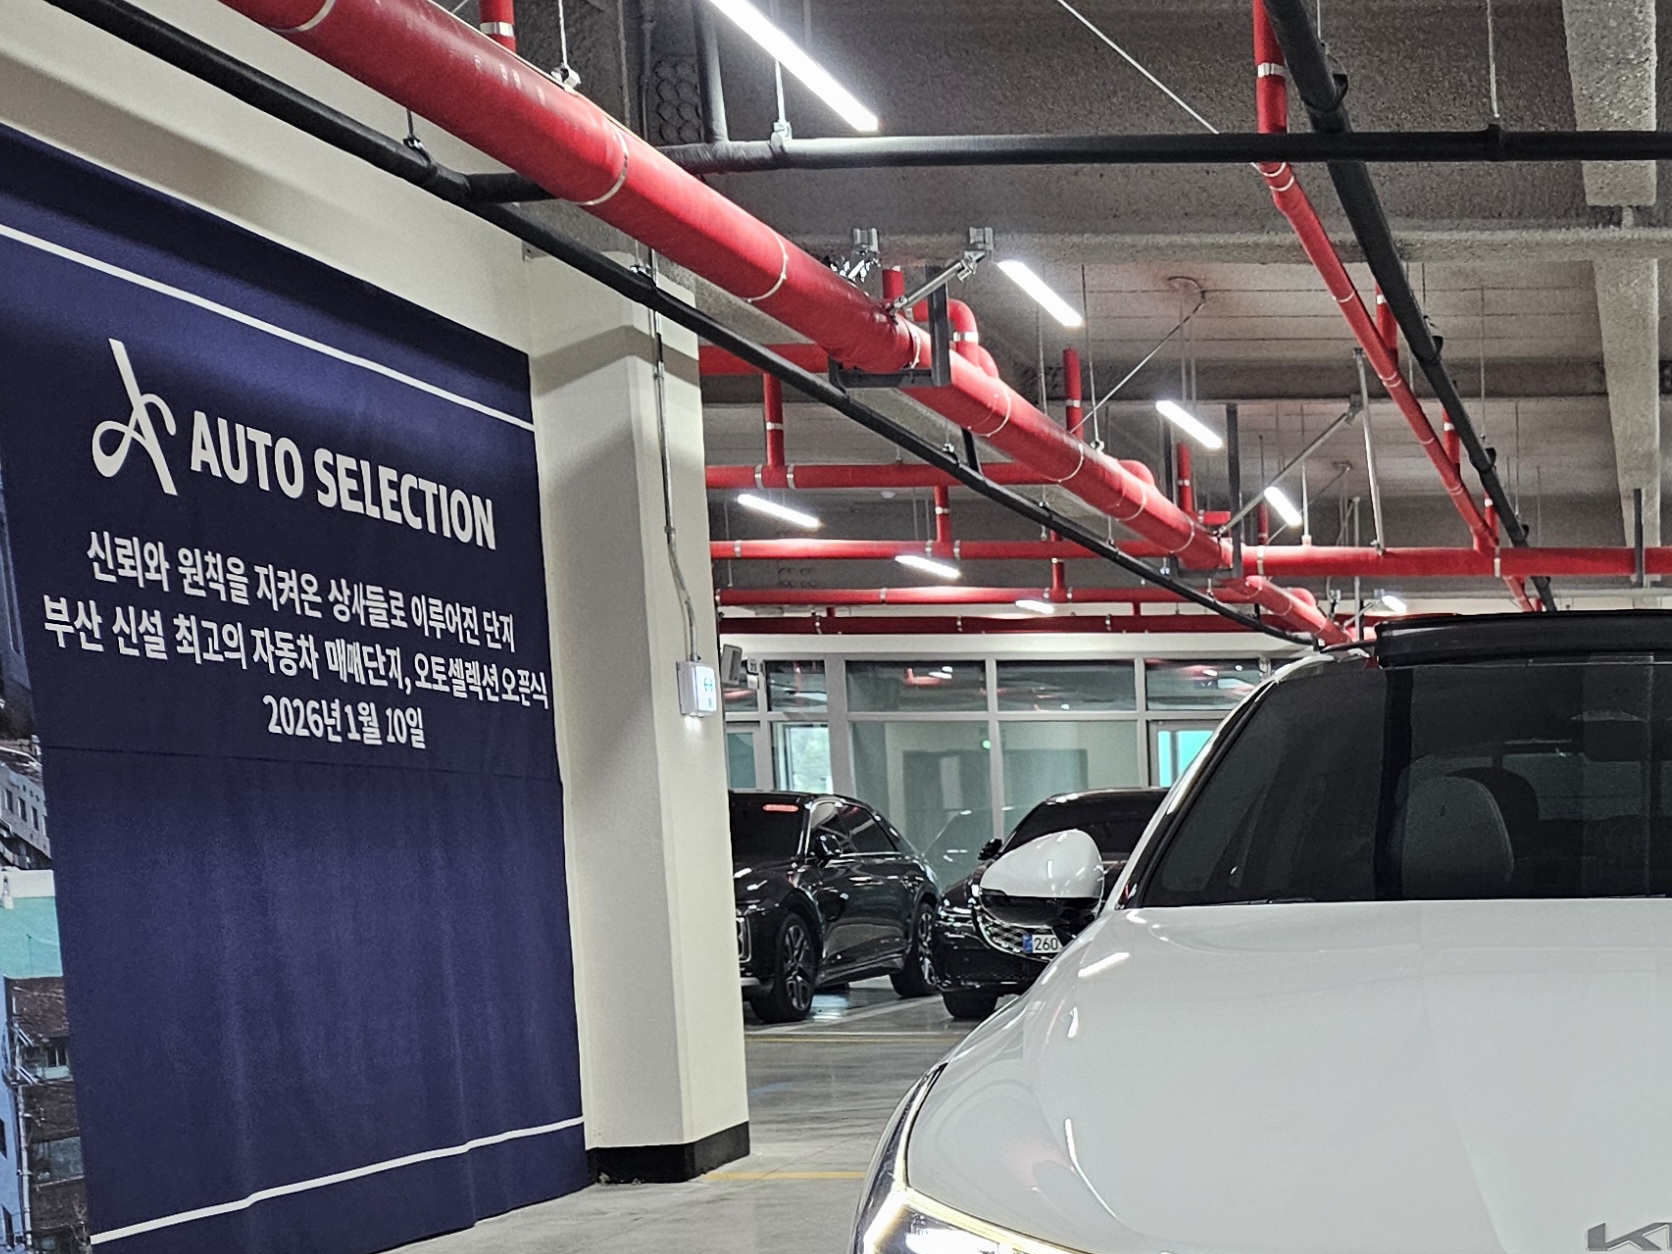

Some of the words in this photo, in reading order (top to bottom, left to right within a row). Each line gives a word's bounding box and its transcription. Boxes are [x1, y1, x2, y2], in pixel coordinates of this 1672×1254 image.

[190, 411, 304, 499] AUTO
[314, 447, 496, 550] SELECTION
[86, 531, 171, 593] 신뢰와
[177, 547, 250, 606] 원칙을
[253, 563, 323, 619] 지켜온
[327, 578, 409, 630] 상사들로
[410, 594, 481, 646] 이루어진
[482, 610, 516, 653] 단지
[43, 594, 105, 653] 부산
[111, 605, 168, 660] 신설
[172, 613, 248, 670] 최고의
[250, 627, 320, 681] 자동차
[324, 638, 412, 696] 매매단지,
[262, 694, 343, 743] 2026년
[344, 702, 383, 746] 1월
[385, 706, 427, 750] 10일
[1034, 937, 1059, 951] 260
